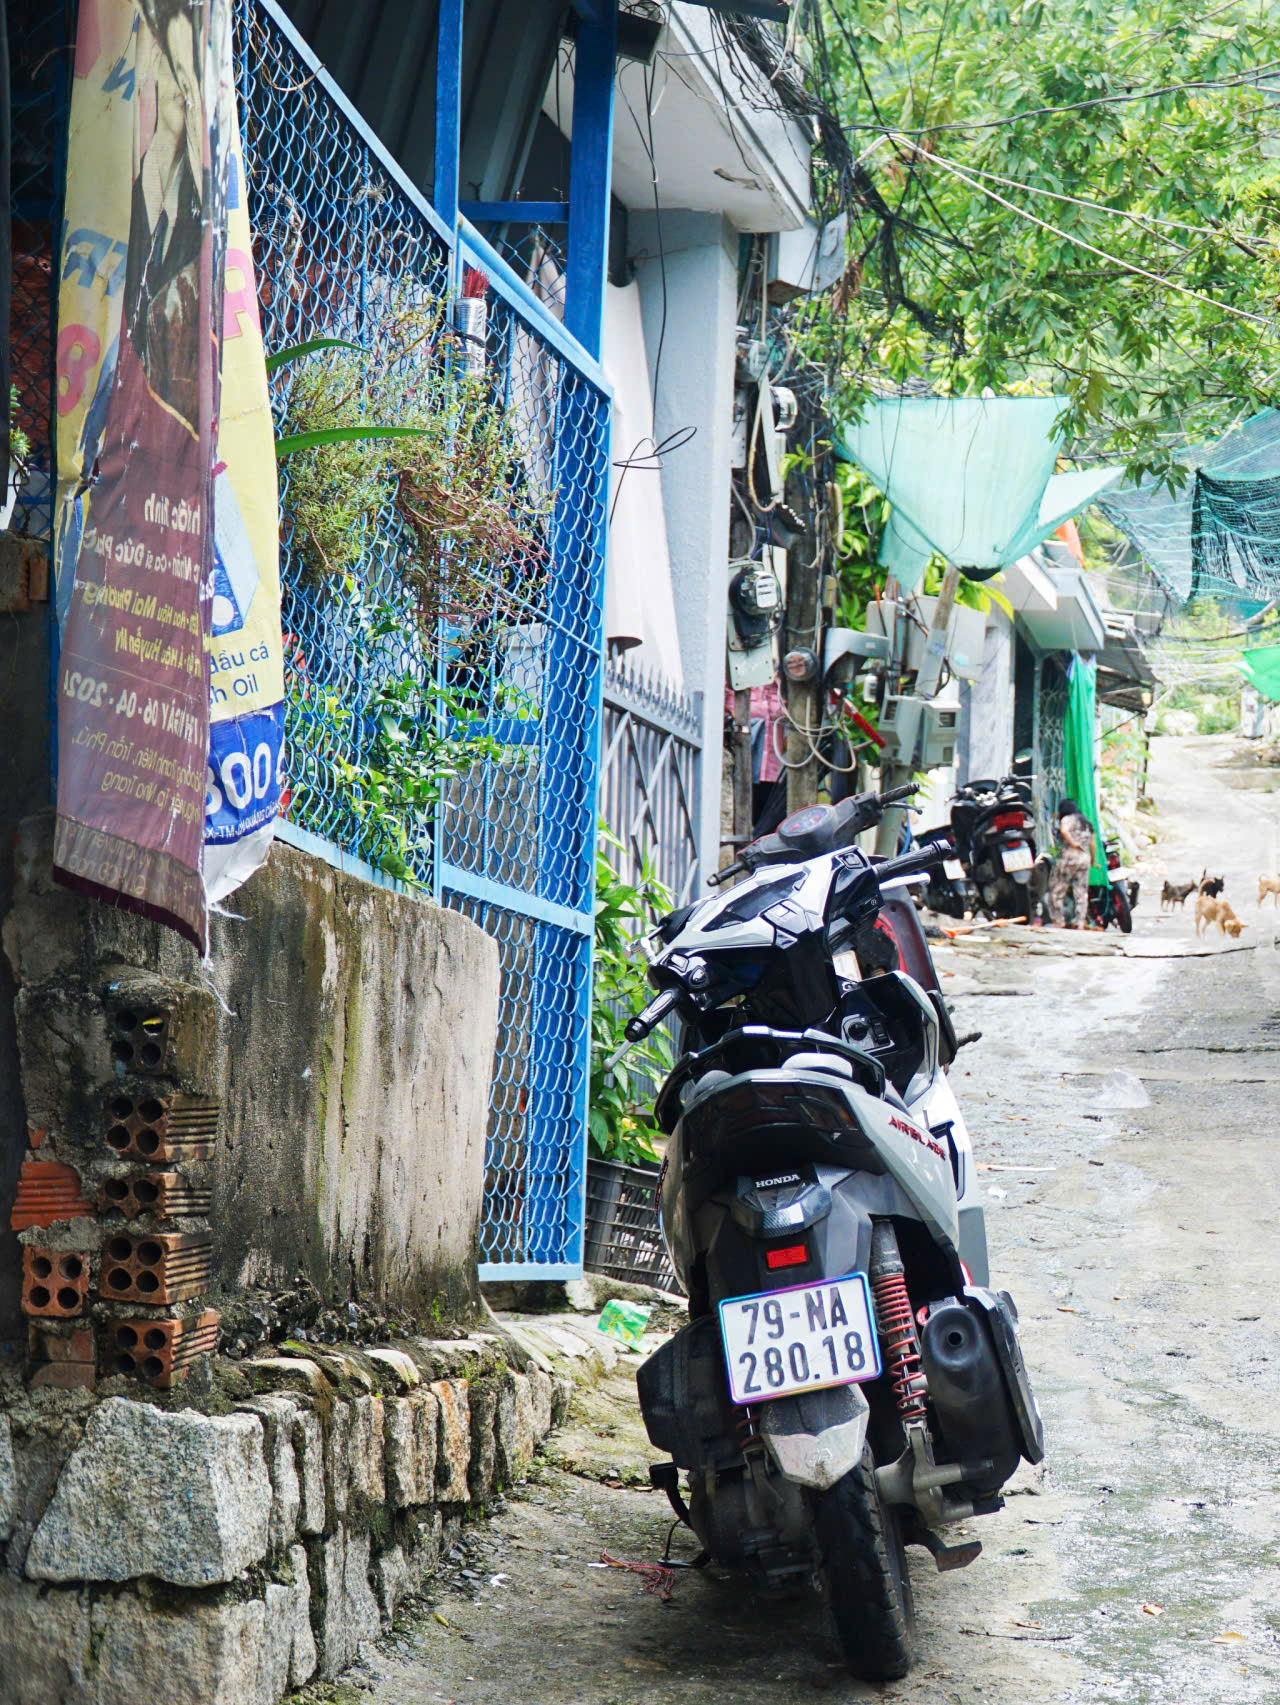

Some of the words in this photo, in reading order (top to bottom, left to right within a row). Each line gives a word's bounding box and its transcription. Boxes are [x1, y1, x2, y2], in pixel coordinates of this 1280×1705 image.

[250, 641, 269, 661] cá
[233, 673, 259, 697] Oil
[755, 1174, 801, 1188] HONDA
[741, 1286, 849, 1345] 79-NA
[739, 1331, 866, 1394] 280.18
